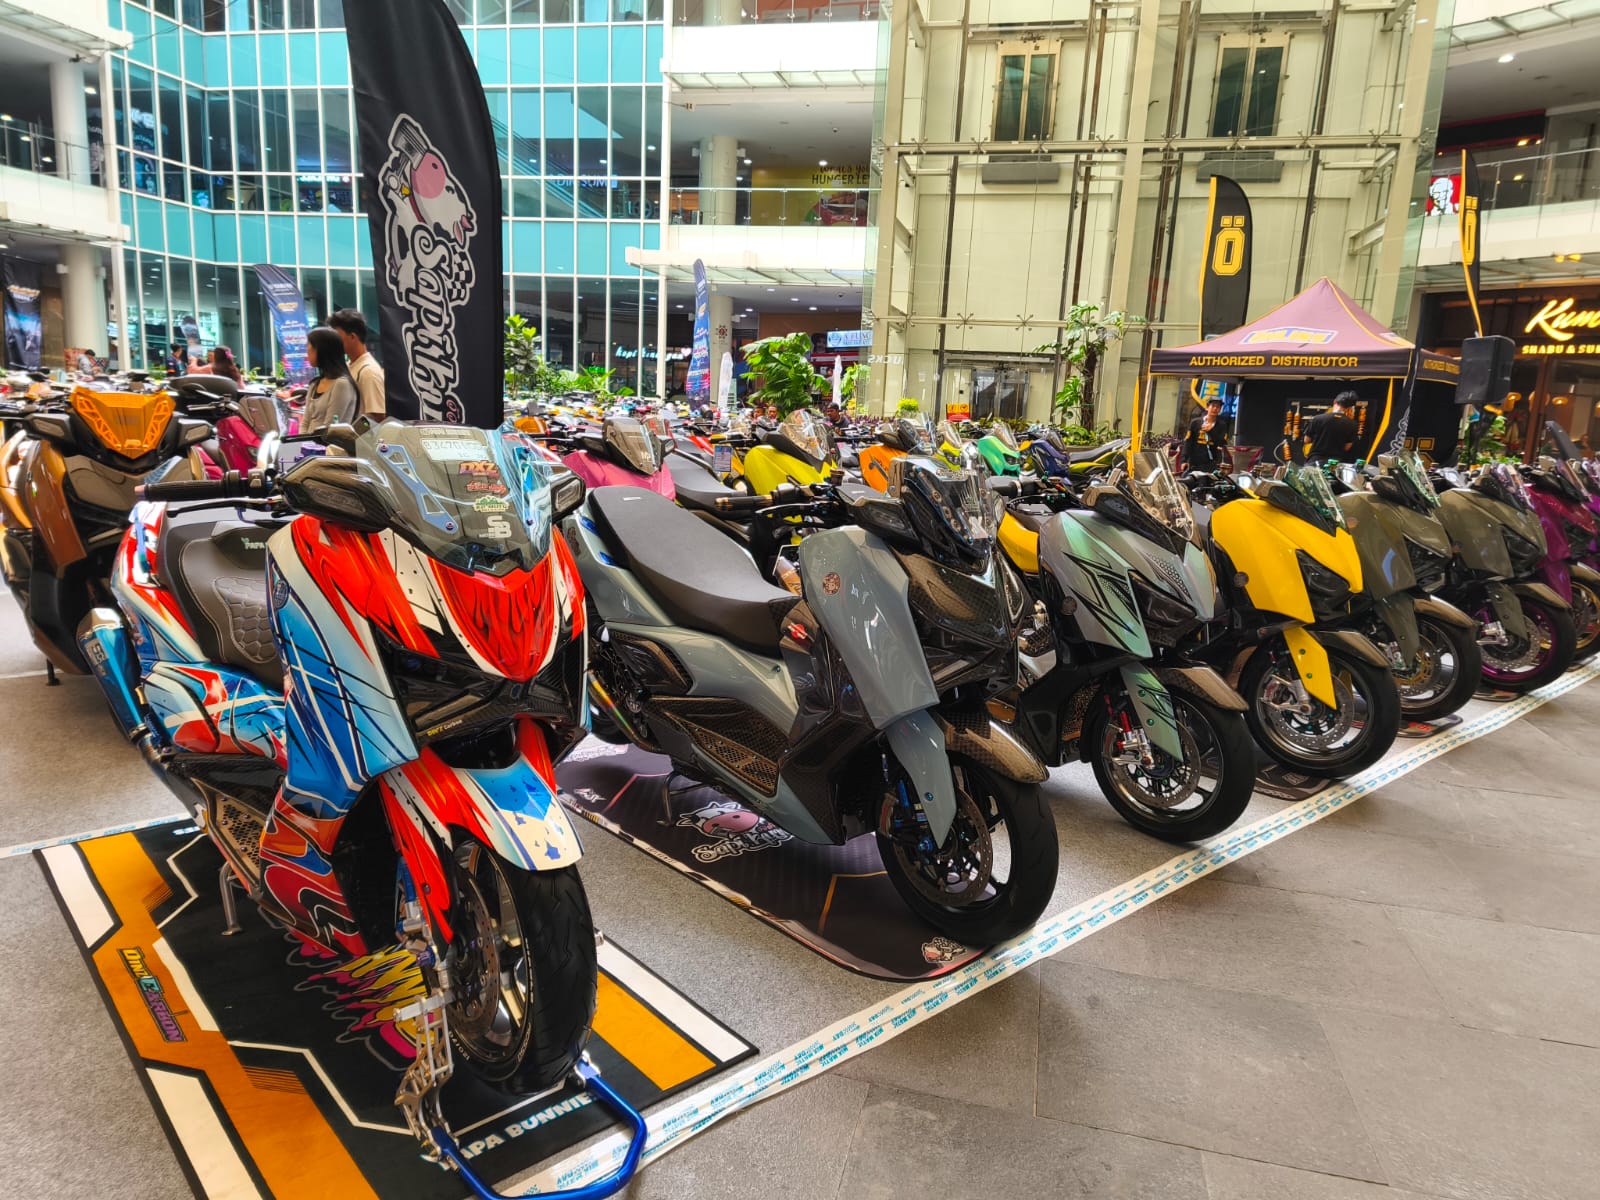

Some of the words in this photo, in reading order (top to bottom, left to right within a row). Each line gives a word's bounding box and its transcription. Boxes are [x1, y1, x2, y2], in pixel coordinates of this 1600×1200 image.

[1189, 356, 1265, 366] AUTHORIZED
[1271, 356, 1358, 367] DISTRIBUTOR
[505, 1092, 598, 1138] BUNNIE
